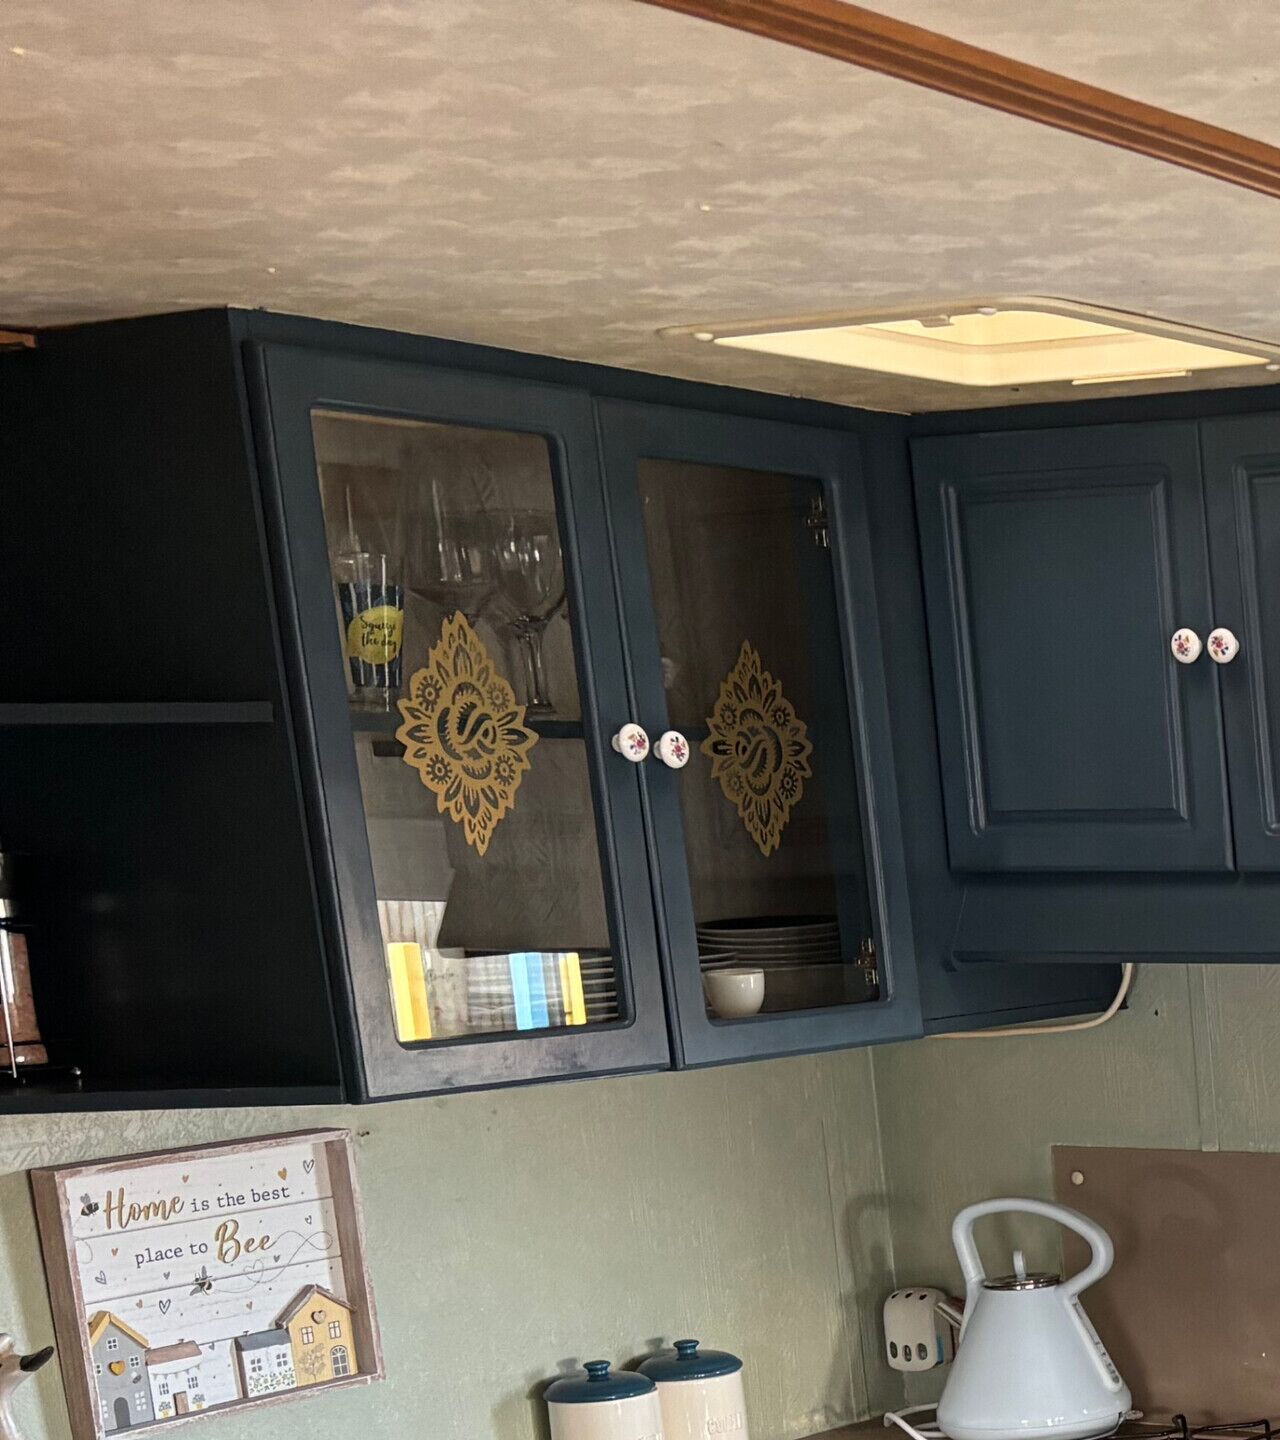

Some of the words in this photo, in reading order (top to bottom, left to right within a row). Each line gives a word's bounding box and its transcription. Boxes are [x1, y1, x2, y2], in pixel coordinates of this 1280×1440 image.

[103, 1187, 185, 1230] Home
[190, 1198, 210, 1213] is
[217, 1192, 246, 1209] the
[250, 1186, 291, 1204] best
[135, 1247, 185, 1269] place
[189, 1241, 209, 1255] to
[214, 1218, 274, 1264] Bee
